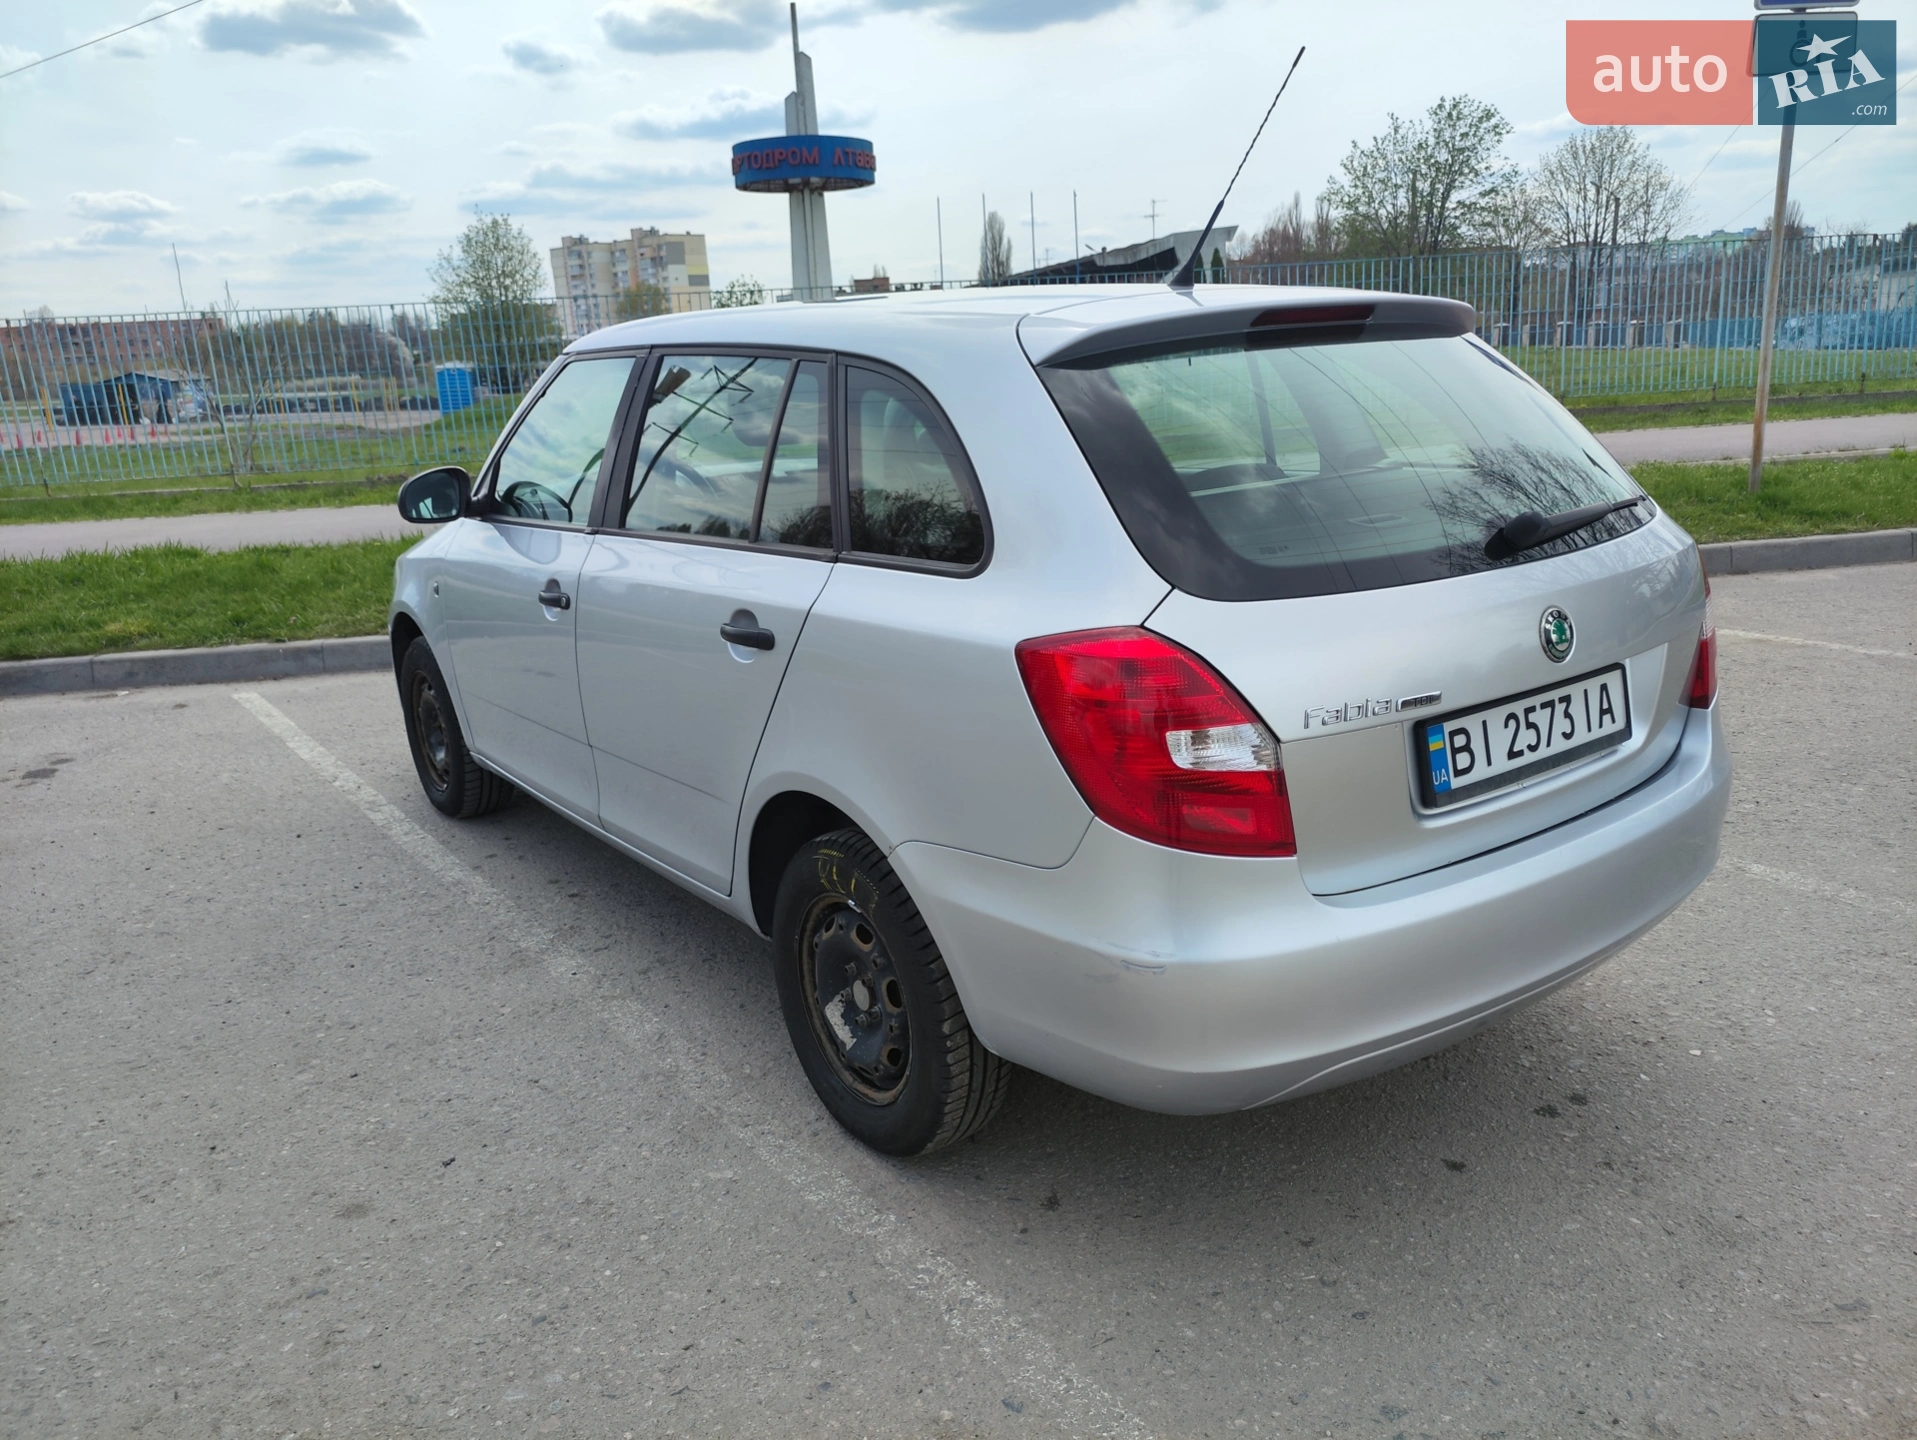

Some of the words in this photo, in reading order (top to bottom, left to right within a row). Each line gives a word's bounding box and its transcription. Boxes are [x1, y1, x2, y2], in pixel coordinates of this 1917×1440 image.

[1304, 698, 1392, 729] Fabia
[1449, 720, 1492, 778] BI
[1504, 694, 1575, 761] 2573
[1583, 682, 1617, 733] IA
[1432, 768, 1449, 785] UA
